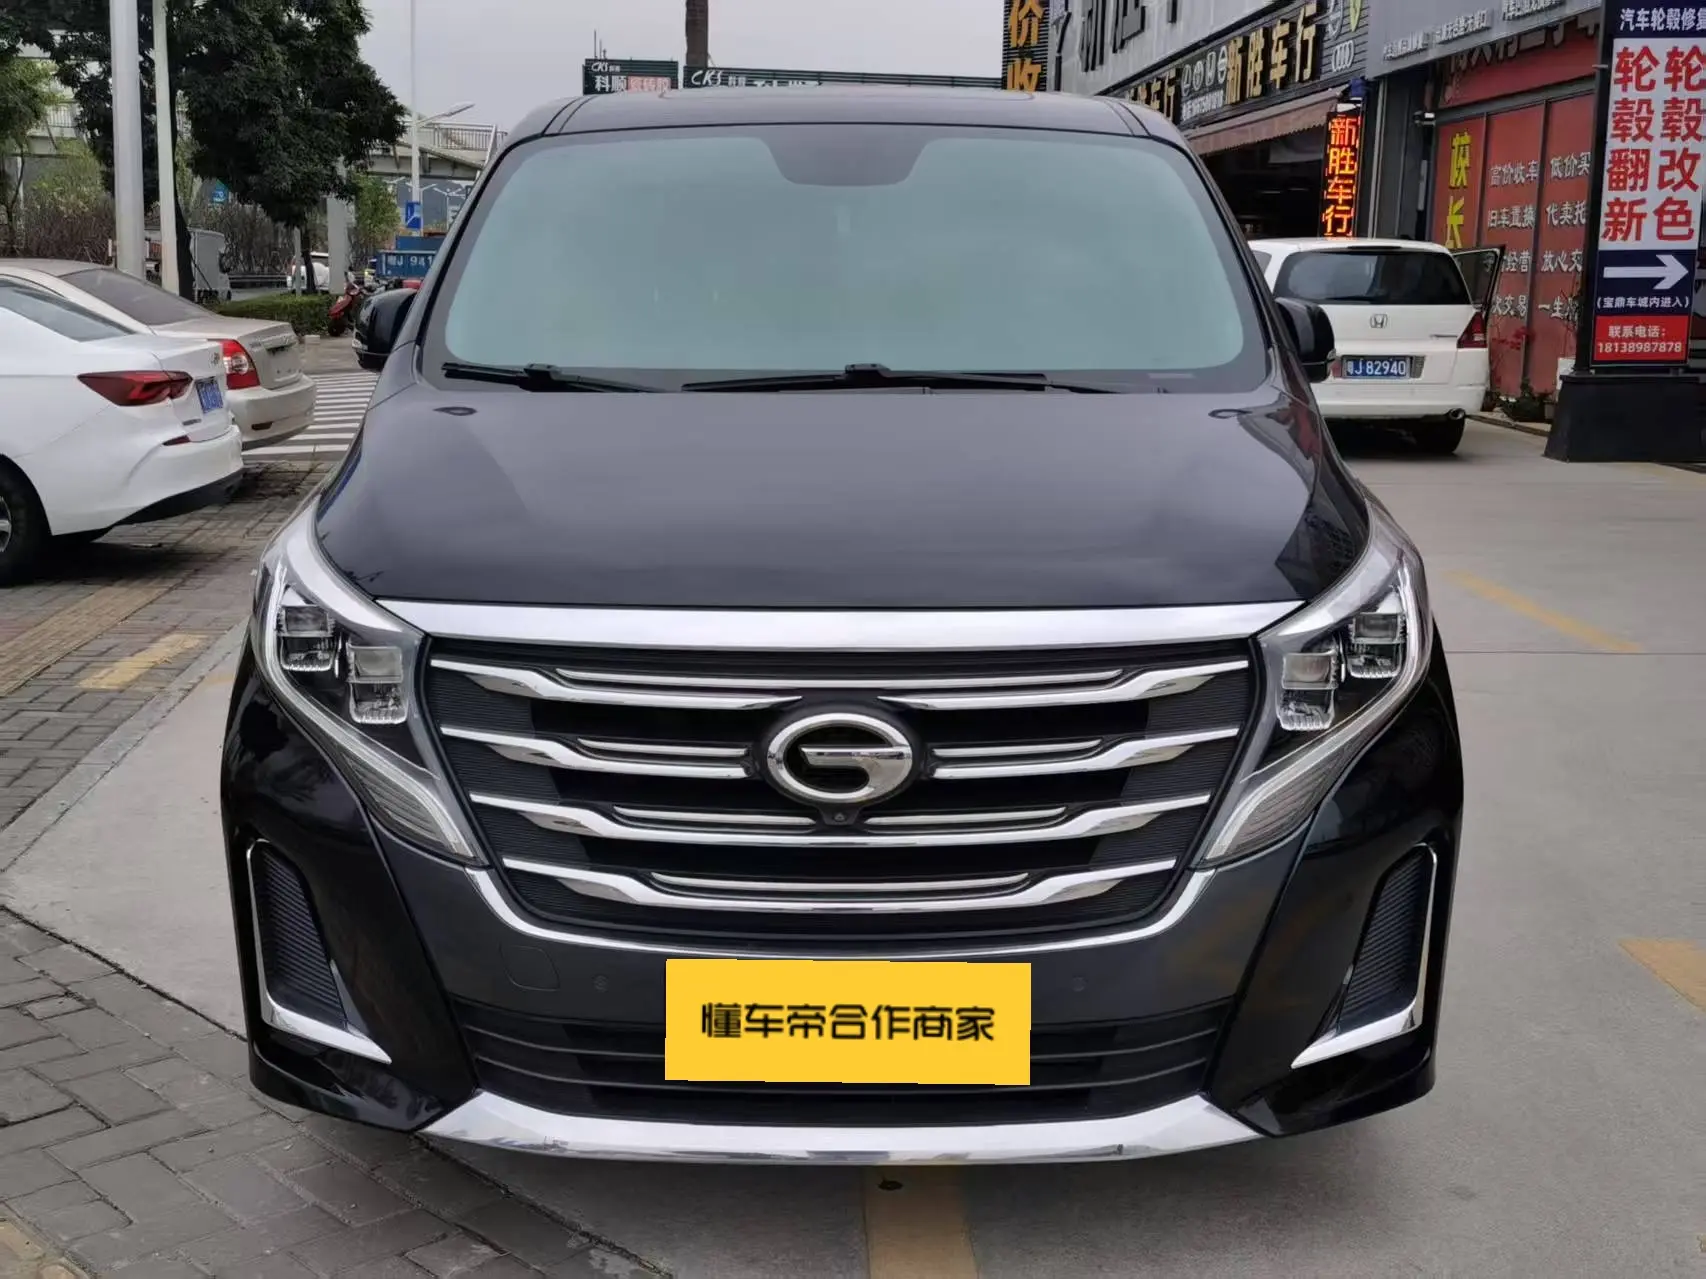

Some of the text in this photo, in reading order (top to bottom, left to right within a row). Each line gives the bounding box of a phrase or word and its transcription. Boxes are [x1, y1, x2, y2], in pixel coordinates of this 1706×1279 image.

[691, 70, 723, 87] CKS
[1226, 1, 1328, 105] 新胜车行
[1127, 67, 1178, 121] 车行
[1601, 45, 1660, 242] 轮毂翻新
[1652, 44, 1706, 242] 轮毂改色
[1324, 117, 1357, 234] 新胜车行
[1490, 160, 1539, 187] 高价收车
[1488, 205, 1536, 229] 旧车置换
[1598, 342, 1682, 353] 18138987878
